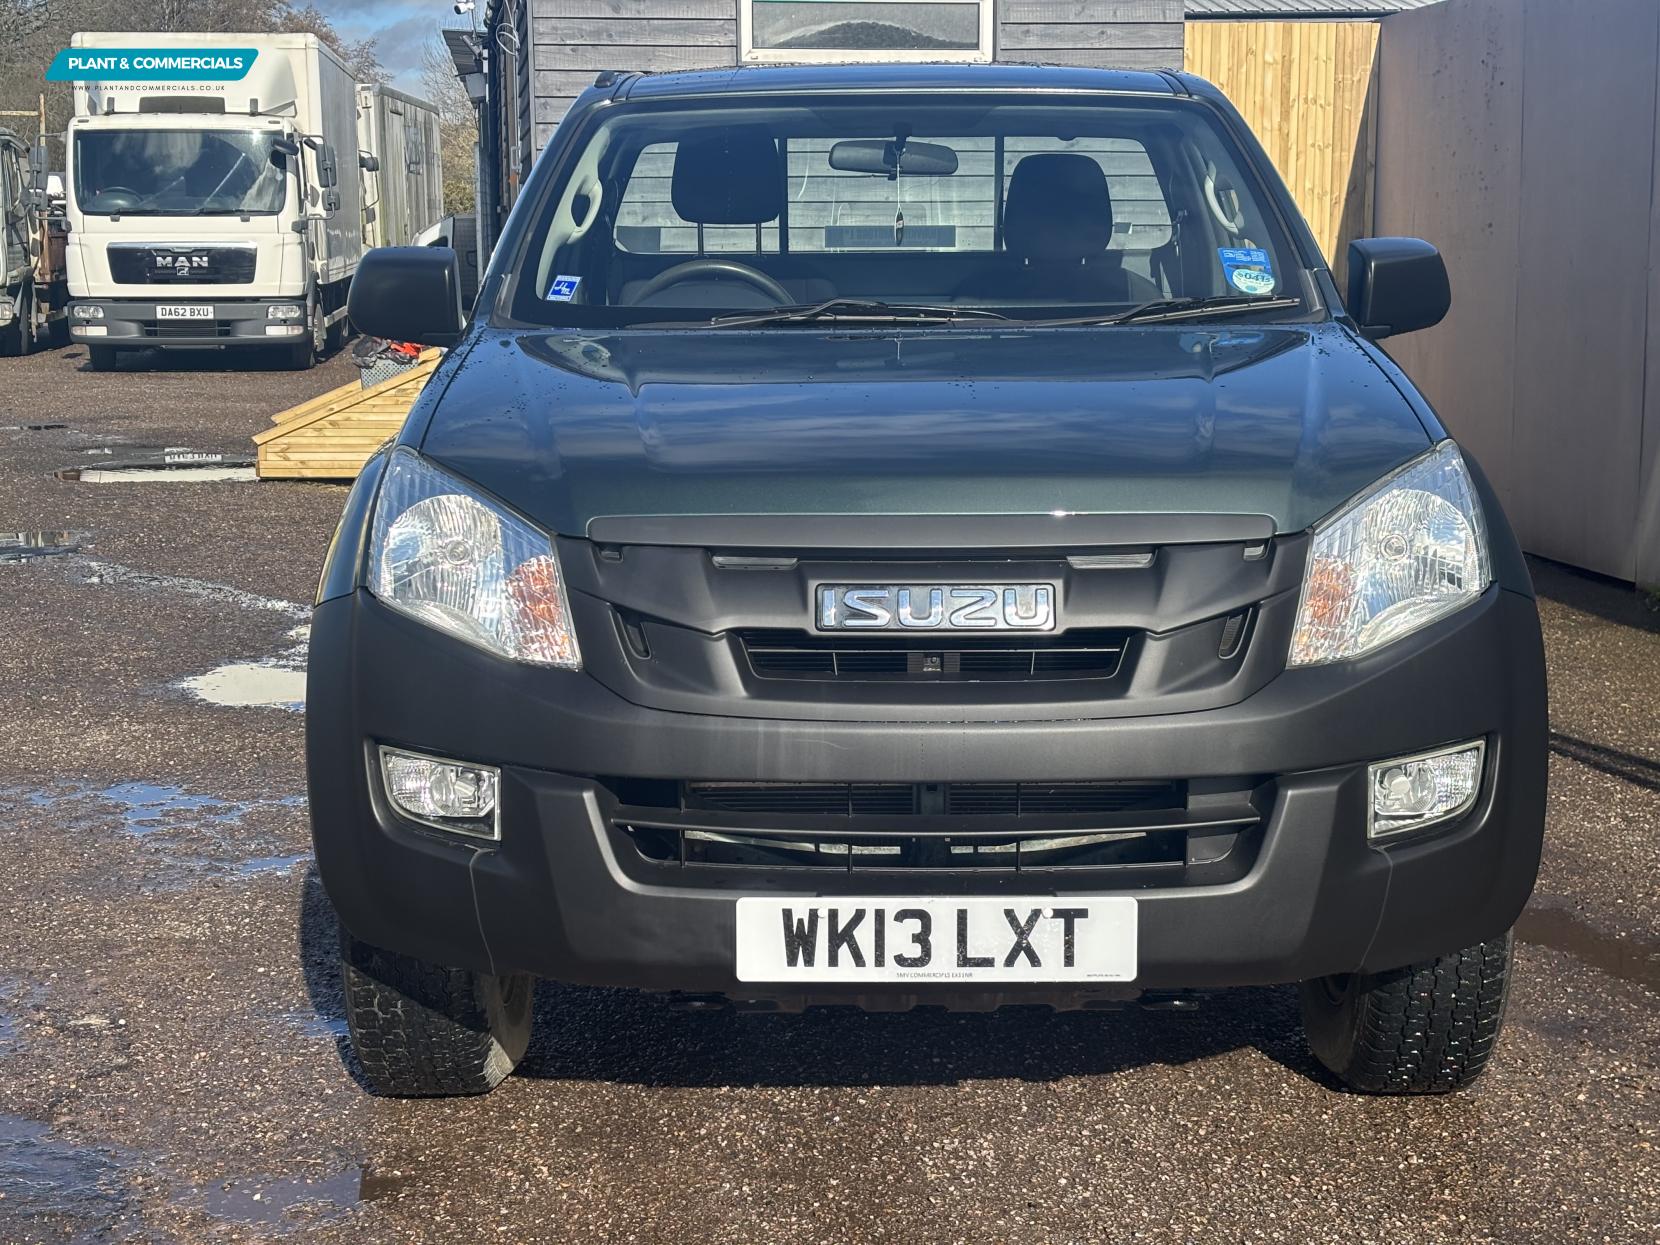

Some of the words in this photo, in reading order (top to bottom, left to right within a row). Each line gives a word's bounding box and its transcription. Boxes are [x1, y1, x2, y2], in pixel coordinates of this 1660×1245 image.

[156, 256, 208, 267] MAN
[161, 307, 187, 317] DA62
[189, 307, 209, 317] BXU
[822, 588, 1050, 627] ISUZU
[781, 908, 932, 967] WK13
[957, 908, 1089, 967] LXT
